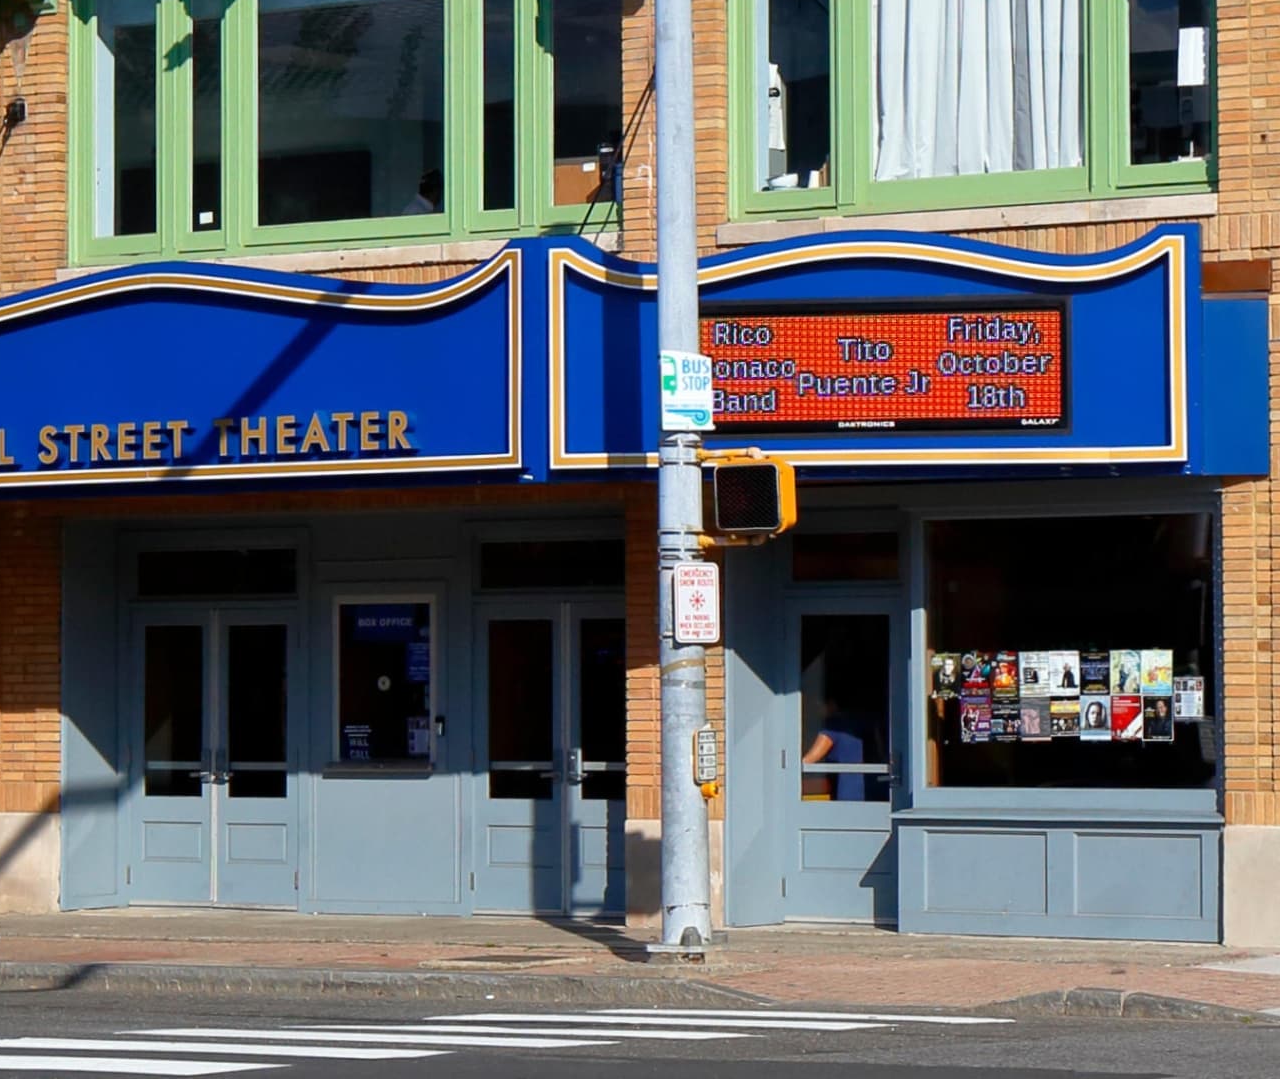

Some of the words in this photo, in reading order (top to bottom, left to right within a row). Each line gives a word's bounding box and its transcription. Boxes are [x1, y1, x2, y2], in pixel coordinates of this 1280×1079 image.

[713, 322, 772, 346] Rico
[947, 315, 1042, 345] Friday,
[837, 337, 893, 362] Tito
[682, 358, 710, 374] BUS
[712, 358, 796, 380] onaco
[937, 351, 1052, 376] October
[682, 375, 710, 391] STOP
[797, 370, 896, 396] Puente
[904, 370, 931, 396] Jr
[711, 388, 777, 413] Band
[967, 385, 1025, 409] 18th
[37, 420, 189, 465] STREET
[213, 410, 412, 457] THEATER
[358, 617, 377, 627] BOX
[379, 617, 413, 627] OFFICE
